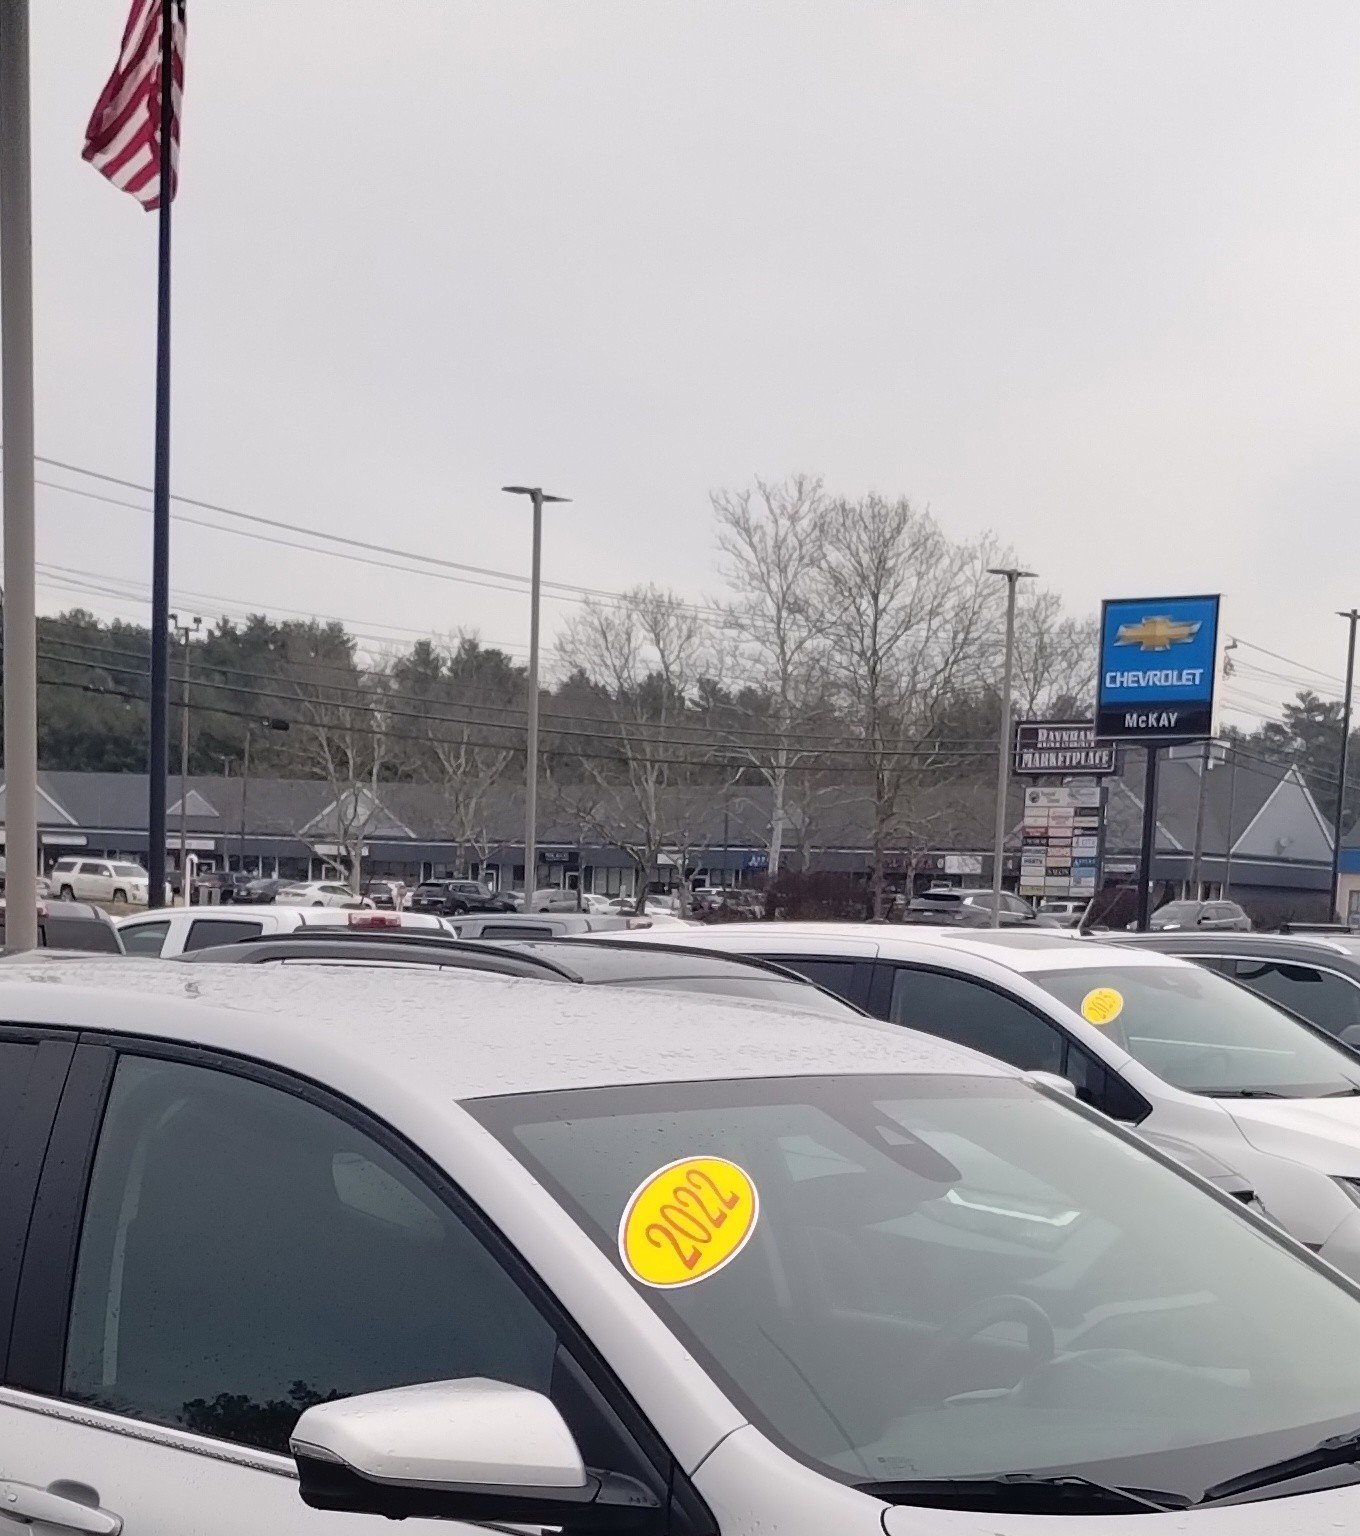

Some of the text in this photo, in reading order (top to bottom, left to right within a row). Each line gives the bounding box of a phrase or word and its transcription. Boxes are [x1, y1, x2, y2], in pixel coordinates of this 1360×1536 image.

[1105, 668, 1204, 688] CHEVROLET
[1124, 712, 1178, 728] McKAY
[1022, 750, 1109, 767] MARKETPLACE
[645, 1169, 740, 1271] 2022
